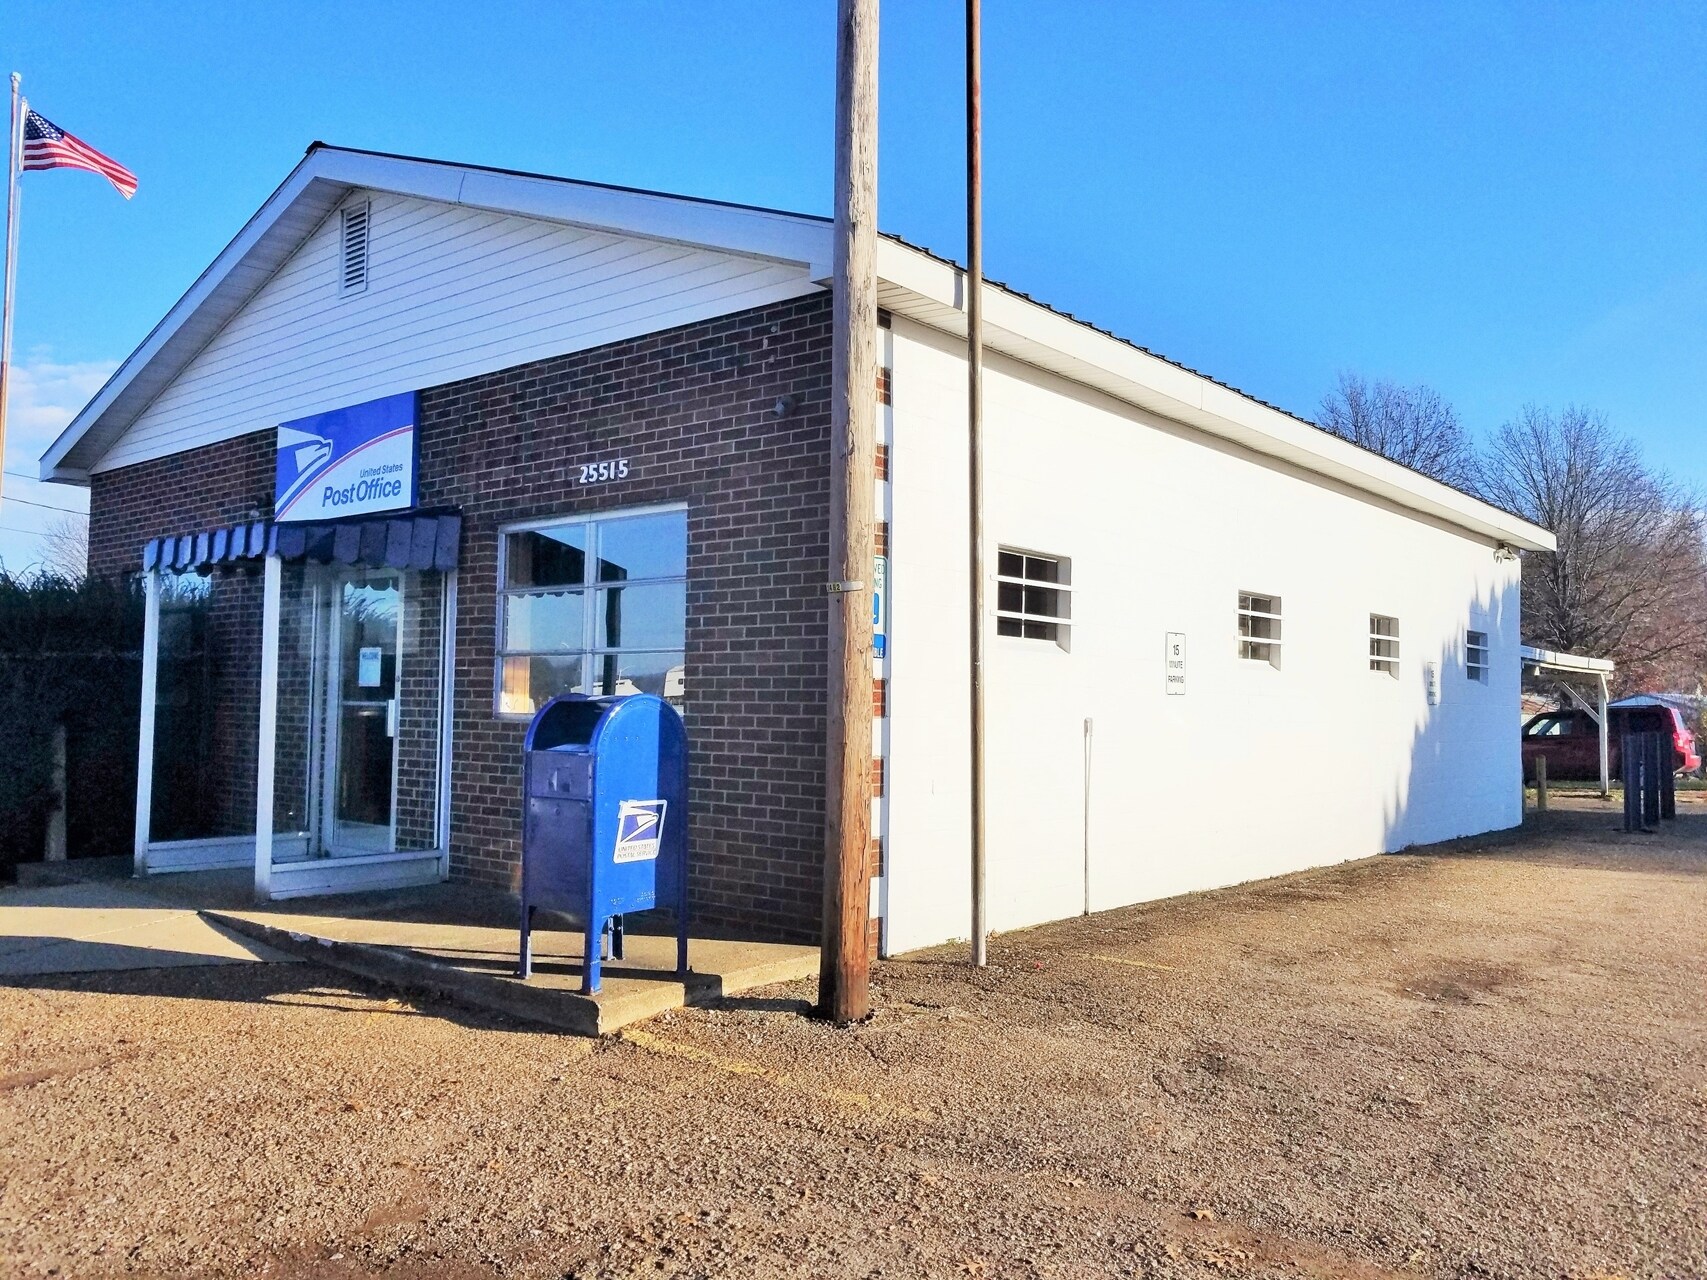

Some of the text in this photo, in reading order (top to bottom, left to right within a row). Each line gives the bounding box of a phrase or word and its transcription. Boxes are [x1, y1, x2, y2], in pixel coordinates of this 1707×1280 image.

[360, 464, 403, 478] United States
[579, 460, 628, 483] 25515
[322, 477, 401, 507] Post Office
[1173, 644, 1180, 656] 15
[1167, 675, 1185, 684] PARKING
